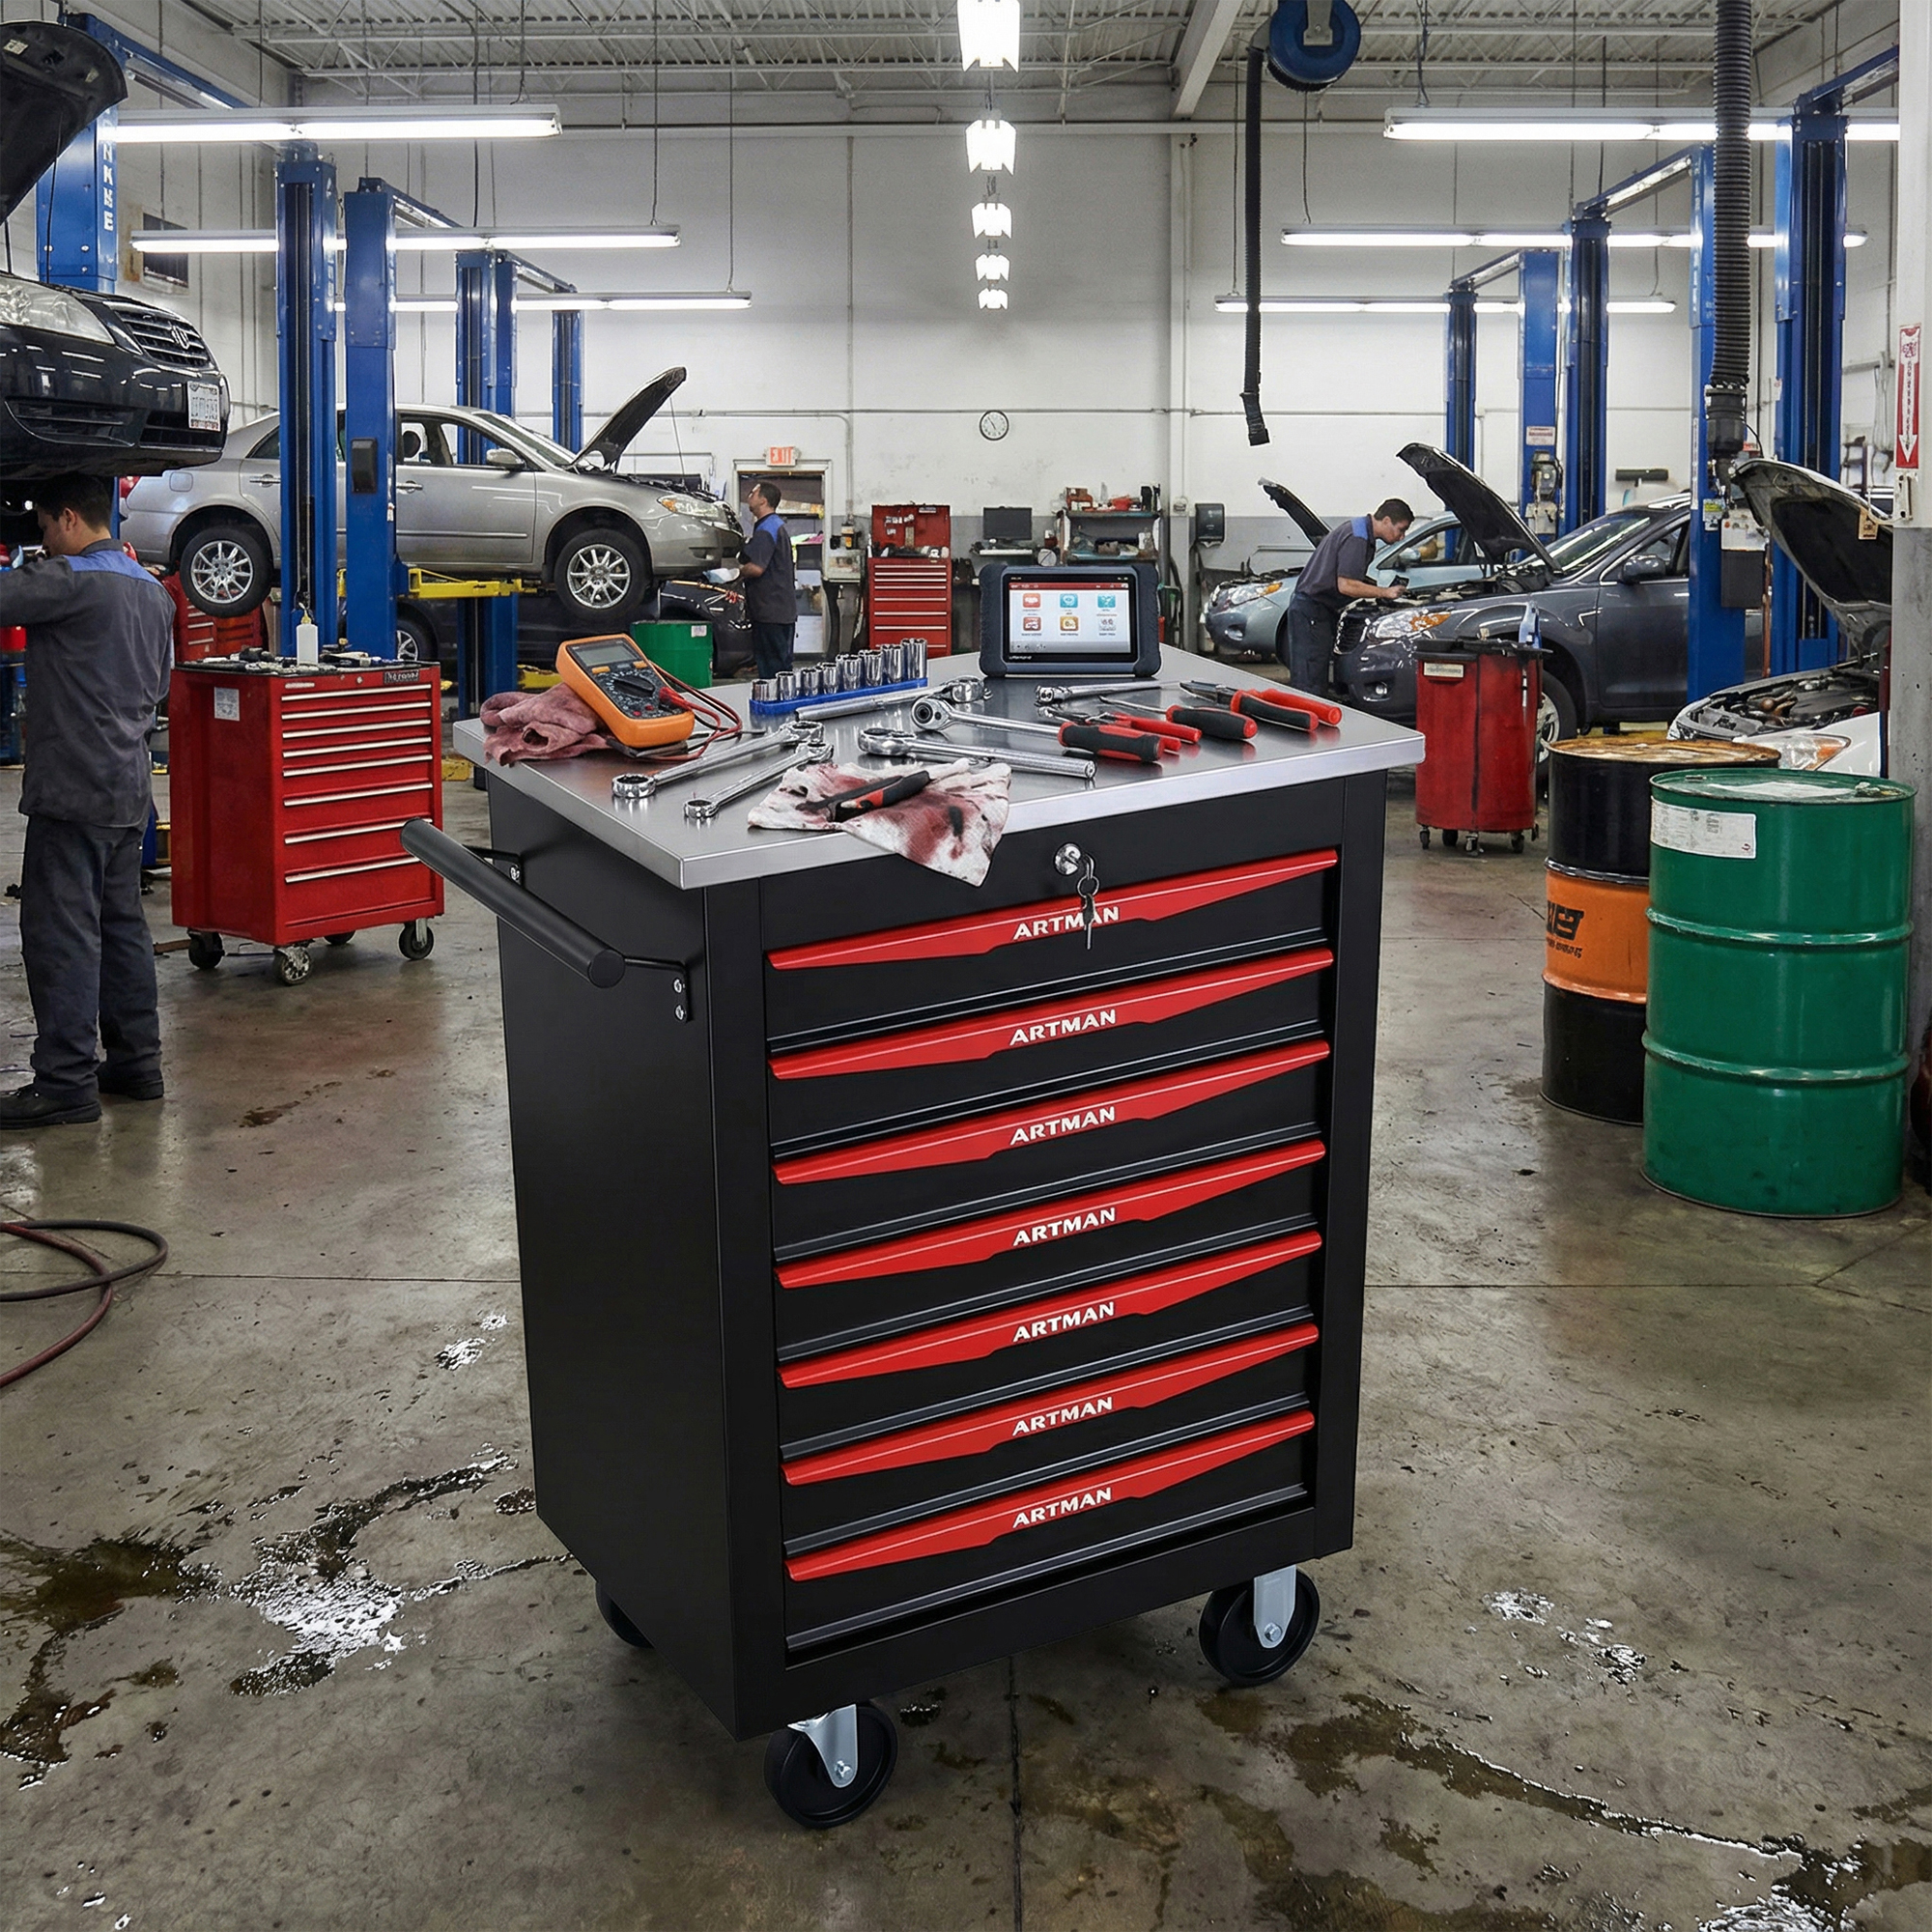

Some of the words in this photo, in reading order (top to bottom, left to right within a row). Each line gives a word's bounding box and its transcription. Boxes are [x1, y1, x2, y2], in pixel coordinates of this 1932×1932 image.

[770, 446, 794, 465] EXIT
[1009, 1009, 1116, 1046] ARTMAN
[1009, 1106, 1115, 1146] ARTMAN
[1011, 1207, 1116, 1246] ARTMAN
[1011, 1301, 1114, 1343] ARTMAN
[1012, 1396, 1113, 1436] ARTMAN
[1011, 1487, 1112, 1528] ARTMAN
